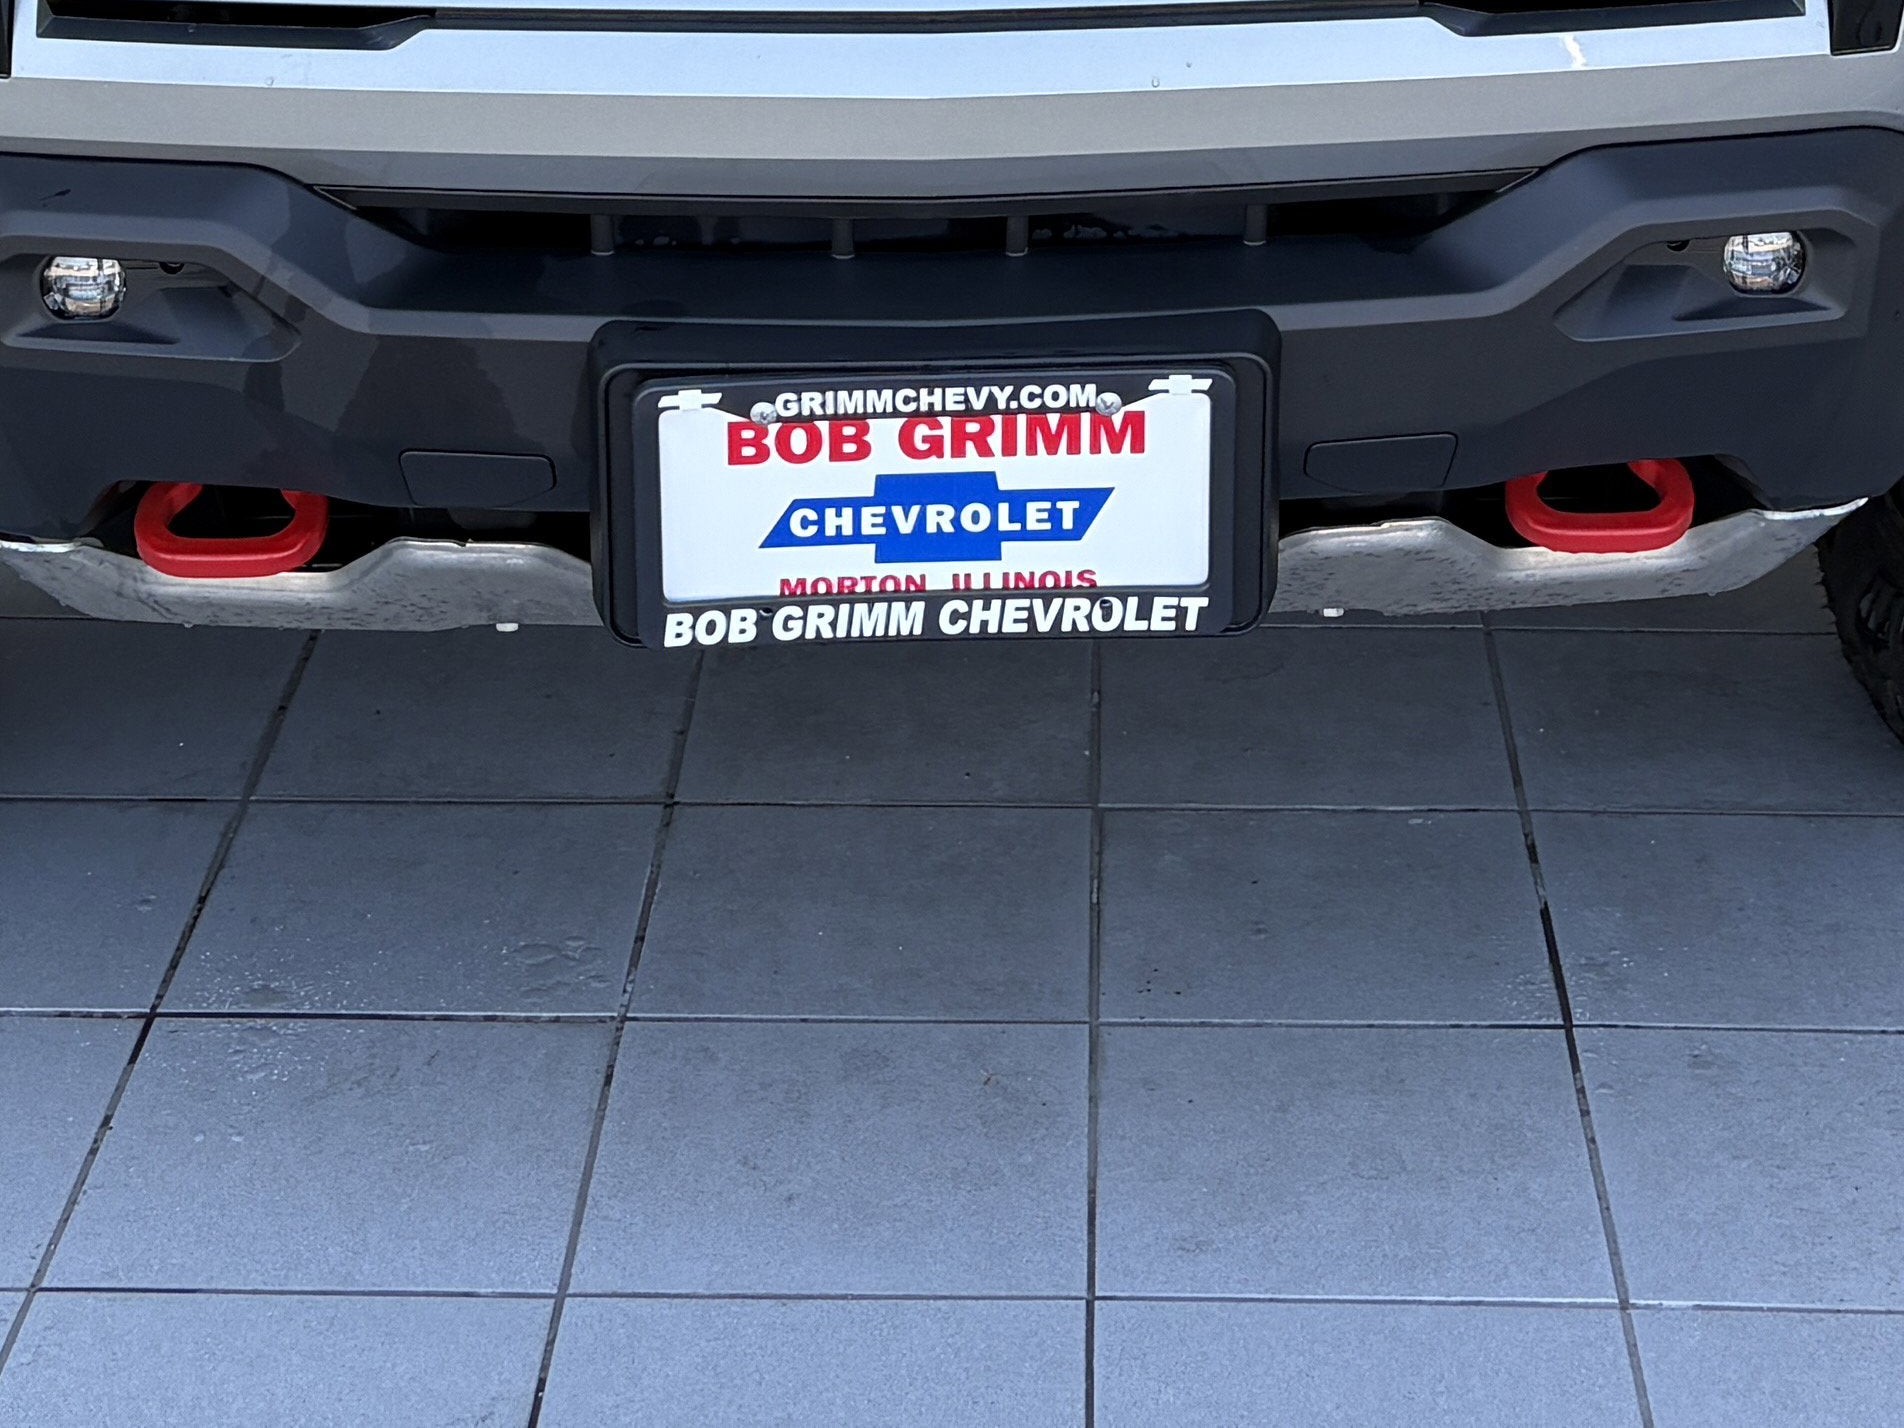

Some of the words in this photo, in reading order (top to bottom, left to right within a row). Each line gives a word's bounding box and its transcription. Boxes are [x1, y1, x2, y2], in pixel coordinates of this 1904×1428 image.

[775, 384, 1097, 418] GRIMMCHEVY.COM
[728, 418, 872, 466] BOB
[898, 410, 1145, 461] GRIMM
[789, 500, 1080, 538] CHEVROLET
[779, 573, 927, 598] MORTON
[952, 569, 1098, 592] ILLINOIS
[664, 608, 758, 648] BOB
[772, 600, 926, 642] GRIMM
[938, 596, 1210, 635] CHEVROLET
